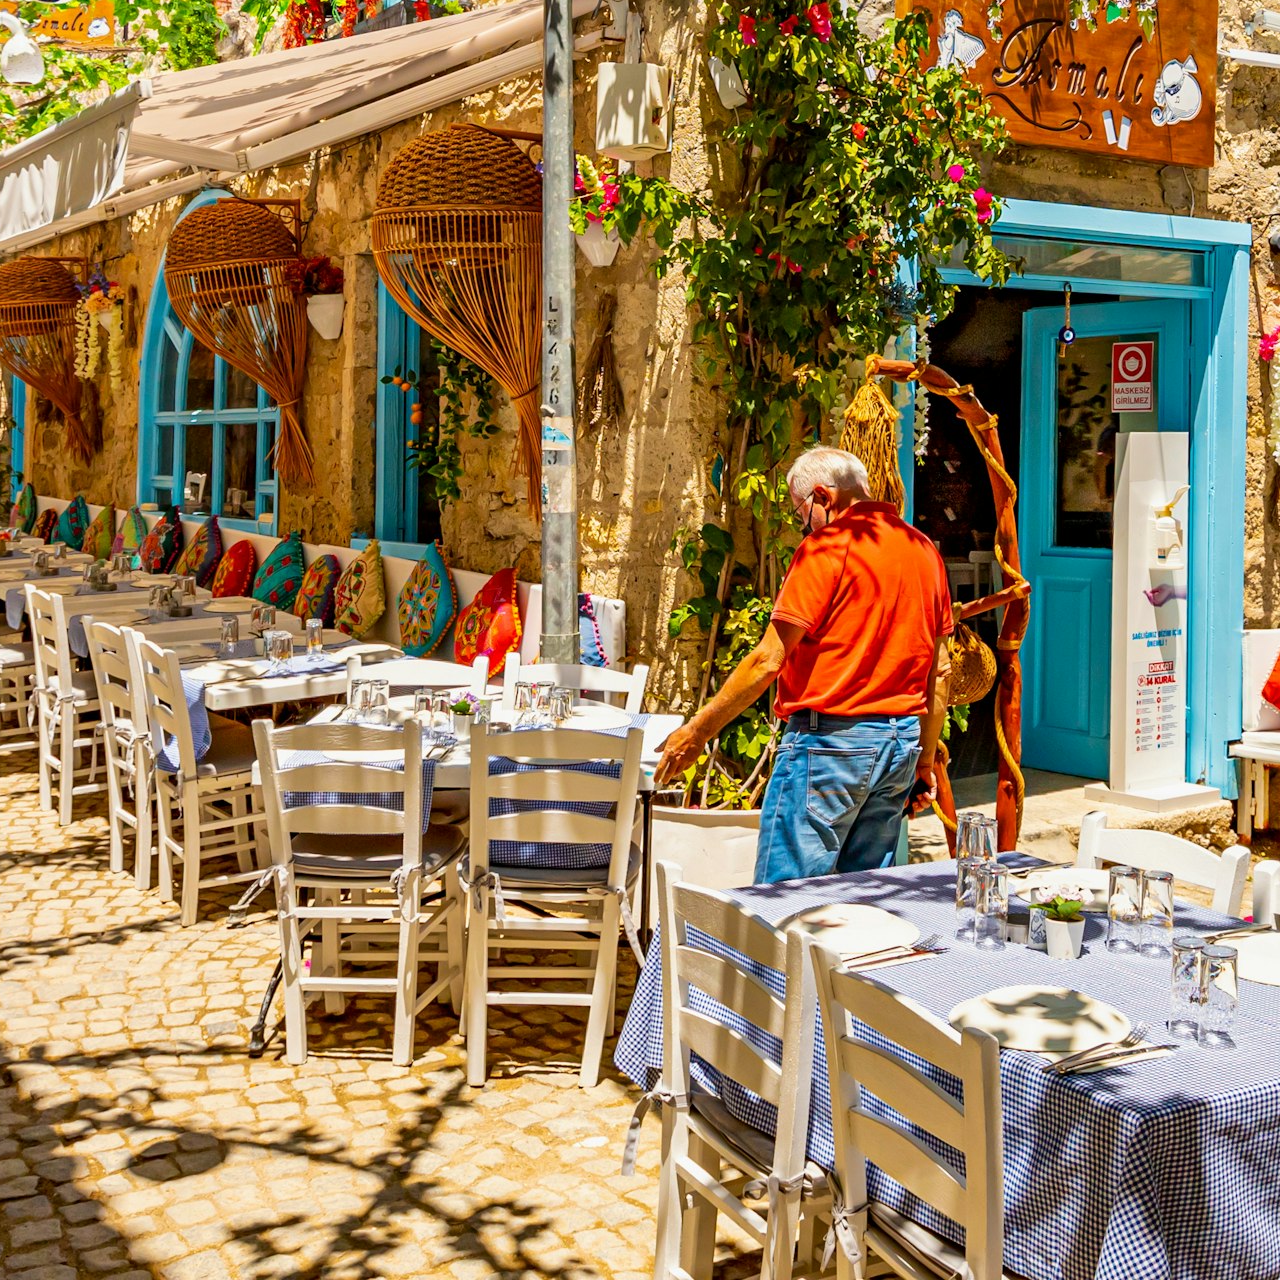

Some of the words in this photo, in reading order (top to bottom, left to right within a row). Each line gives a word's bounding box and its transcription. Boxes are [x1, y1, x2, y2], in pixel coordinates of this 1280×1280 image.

[992, 18, 1144, 104] Asmalı
[1114, 386, 1150, 395] MASKESİZ
[1115, 396, 1149, 405] GİRİLMEZ
[1150, 662, 1173, 672] DİKKAT
[1154, 674, 1176, 685] KURAL
